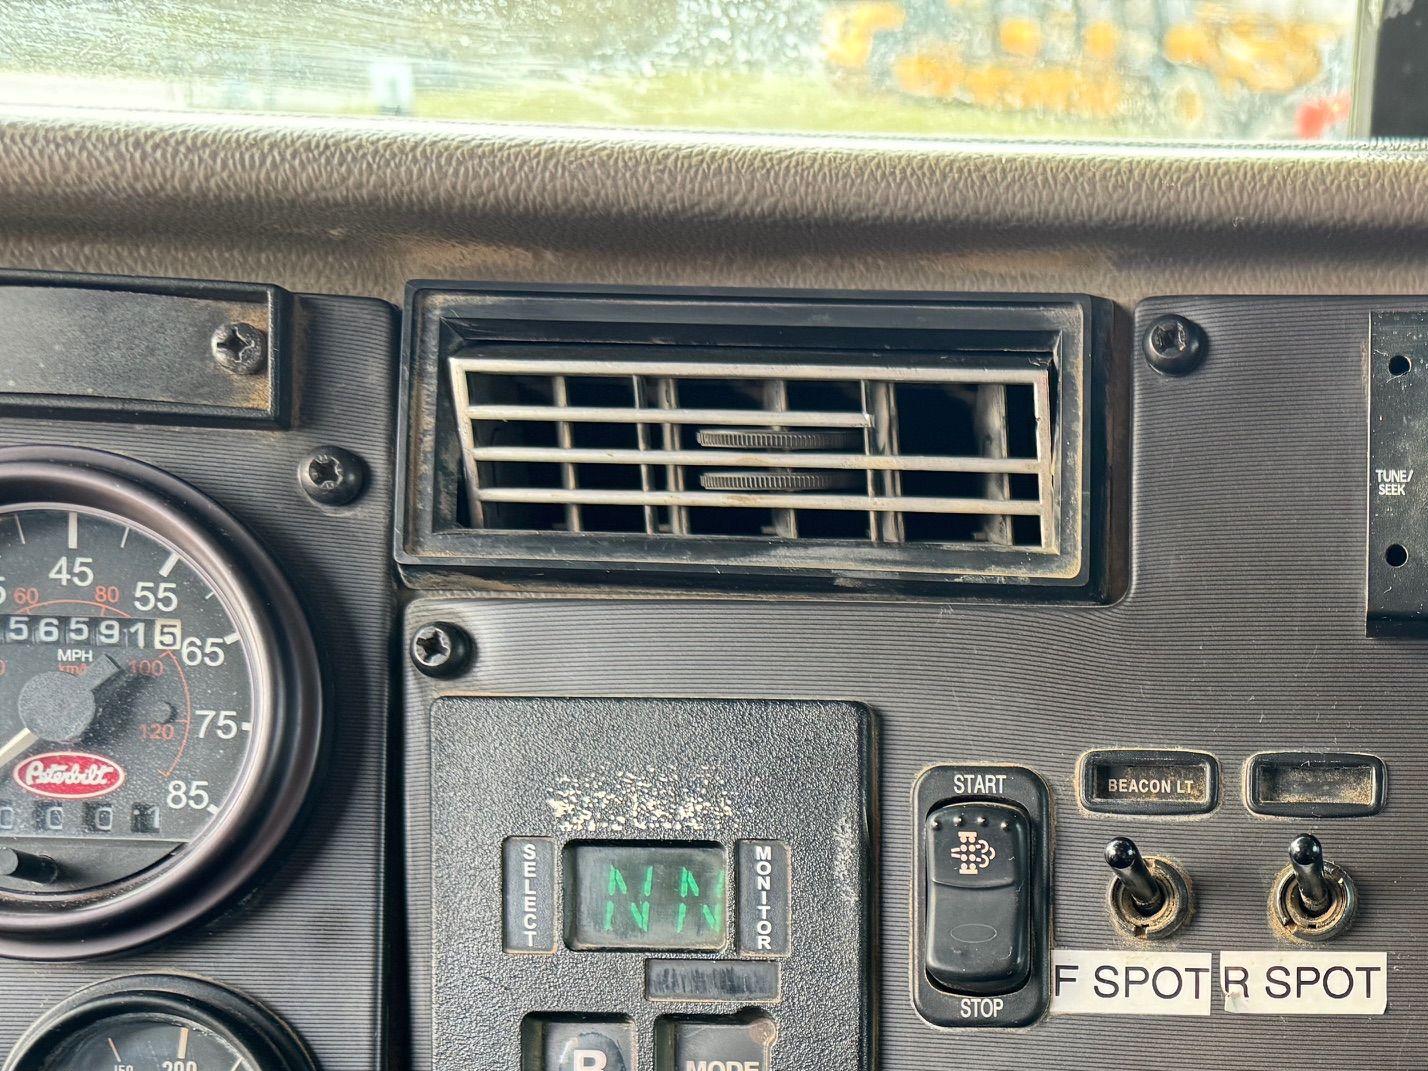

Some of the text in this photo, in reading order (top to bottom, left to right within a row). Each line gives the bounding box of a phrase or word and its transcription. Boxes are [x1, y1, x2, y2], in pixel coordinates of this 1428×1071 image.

[1375, 469, 1414, 483] TUNE/
[1378, 483, 1406, 496] SEEK
[48, 556, 95, 587] 45
[14, 587, 39, 605] 60
[95, 586, 120, 603] 80
[133, 581, 178, 612] 55
[57, 648, 94, 662] MPH
[181, 637, 225, 667] 65
[128, 659, 165, 678] 100
[140, 724, 175, 740] 120
[195, 710, 238, 739] 75
[25, 760, 115, 787] Peterbilt
[953, 774, 1007, 795] START
[166, 779, 210, 810] 85
[1108, 778, 1194, 794] BEACON LT
[523, 843, 538, 948] SELECT
[755, 845, 773, 950] MONITOR
[1055, 963, 1210, 999] F SPOT
[1224, 965, 1382, 999] R SPOT
[960, 998, 1004, 1018] STOP
